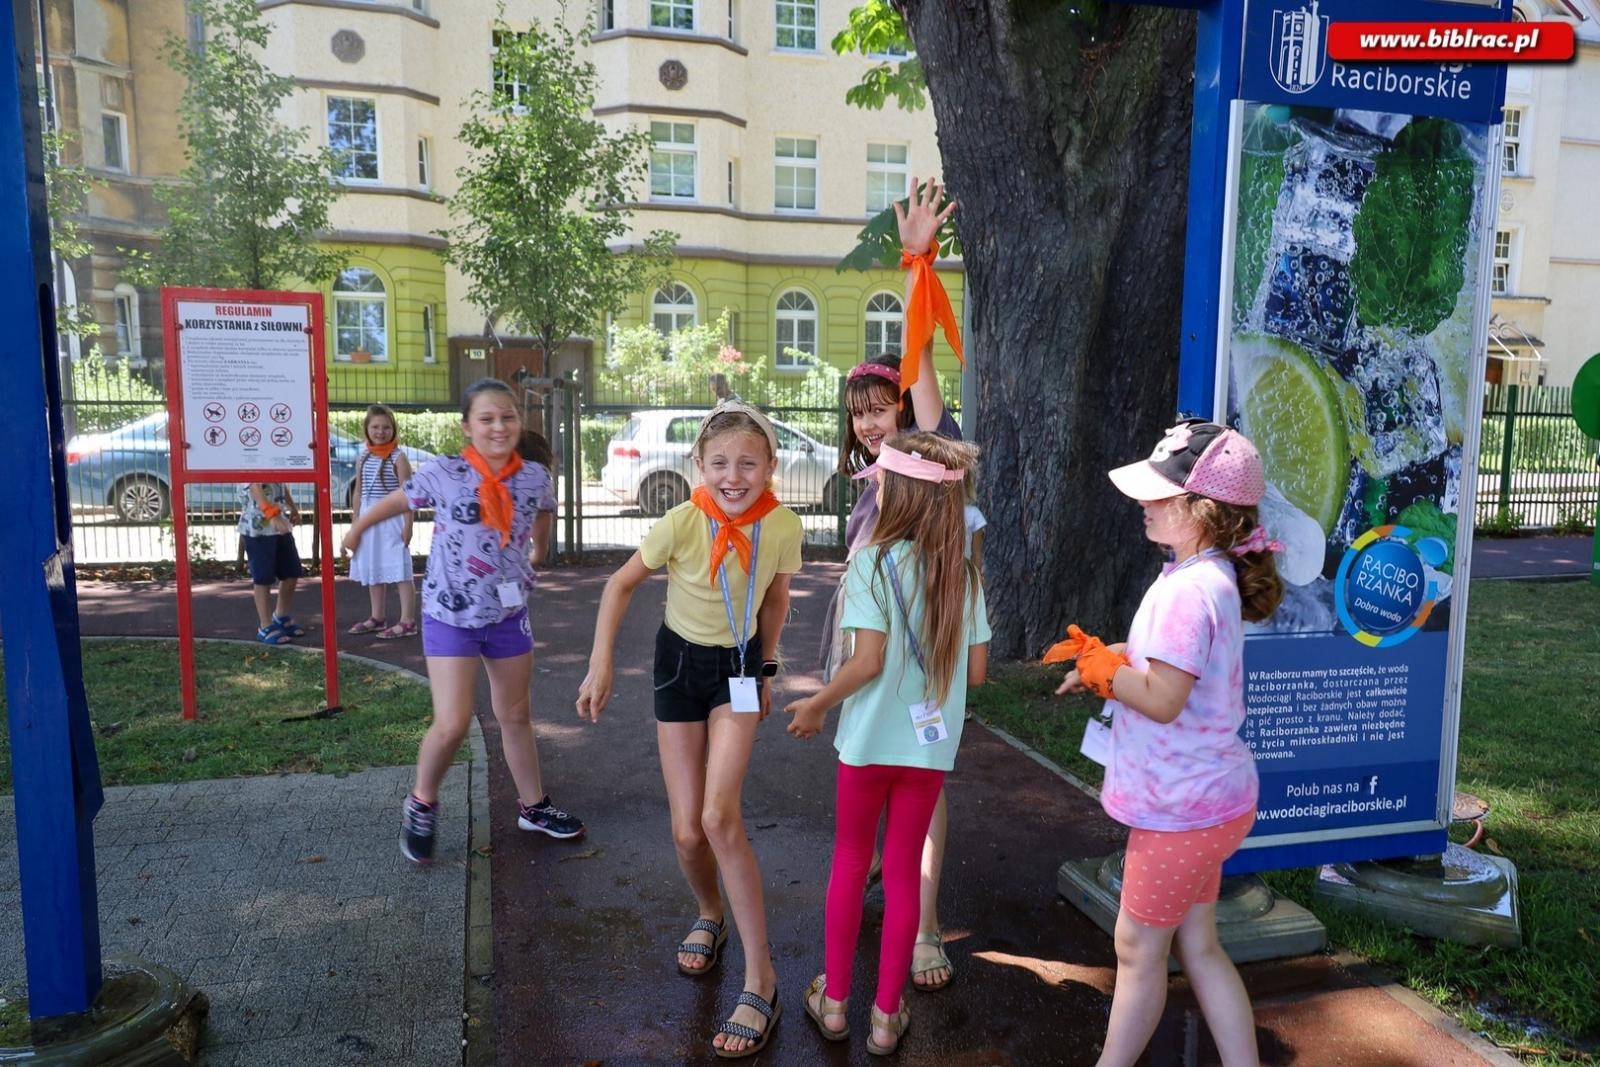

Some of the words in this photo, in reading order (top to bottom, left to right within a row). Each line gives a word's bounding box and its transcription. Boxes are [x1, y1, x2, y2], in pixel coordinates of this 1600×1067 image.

[1331, 62, 1472, 99] Raciborskie
[215, 306, 272, 317] REGULAMIN
[184, 318, 252, 332] KORZYSTANIA
[254, 322, 259, 331] z
[260, 320, 303, 332] SIŁOWNI
[1362, 554, 1418, 588] RACIBO
[1356, 571, 1412, 606] RZANKA
[1354, 597, 1379, 614] Dobra
[1380, 608, 1402, 622] woda
[1249, 672, 1258, 680] W
[1260, 670, 1300, 680] Raciborzu
[1302, 670, 1328, 679] mamy
[1329, 668, 1338, 676] to
[1339, 665, 1376, 677] szczęście,
[1378, 666, 1386, 674] że
[1388, 664, 1408, 673] woda
[1248, 680, 1318, 692] Raciborzanka,
[1323, 677, 1379, 688] dostarczana
[1384, 676, 1408, 686] przez
[1248, 693, 1291, 703] Wodociągi
[1296, 689, 1342, 701] Raciborskie
[1347, 689, 1361, 700] jest
[1366, 686, 1408, 697] całkowicie
[1247, 705, 1293, 716] bezpieczna
[1297, 704, 1299, 712] i
[1303, 703, 1317, 712] bez
[1320, 700, 1352, 711] żadnych
[1356, 699, 1378, 709] obaw
[1381, 698, 1406, 707] można
[1246, 717, 1254, 728] ją
[1259, 716, 1271, 727] pić
[1276, 716, 1304, 726] prosto
[1317, 713, 1342, 722] kranu.
[1348, 710, 1375, 721] Należy
[1260, 726, 1319, 737] Raciborzanka
[1324, 722, 1357, 733] zawiera
[1362, 720, 1405, 730] niezbędne
[1245, 740, 1256, 749] do
[1262, 738, 1285, 750] życia
[1290, 732, 1358, 746] mikroskładniki
[1363, 732, 1365, 741] i
[1370, 732, 1384, 740] nie
[1388, 731, 1404, 741] jest
[1250, 750, 1296, 760] lorowana.
[1287, 782, 1320, 797] Polub
[1323, 783, 1342, 795] nas
[1345, 782, 1360, 793] na
[1256, 795, 1407, 820] w.wodociagiraciborskie.pl
